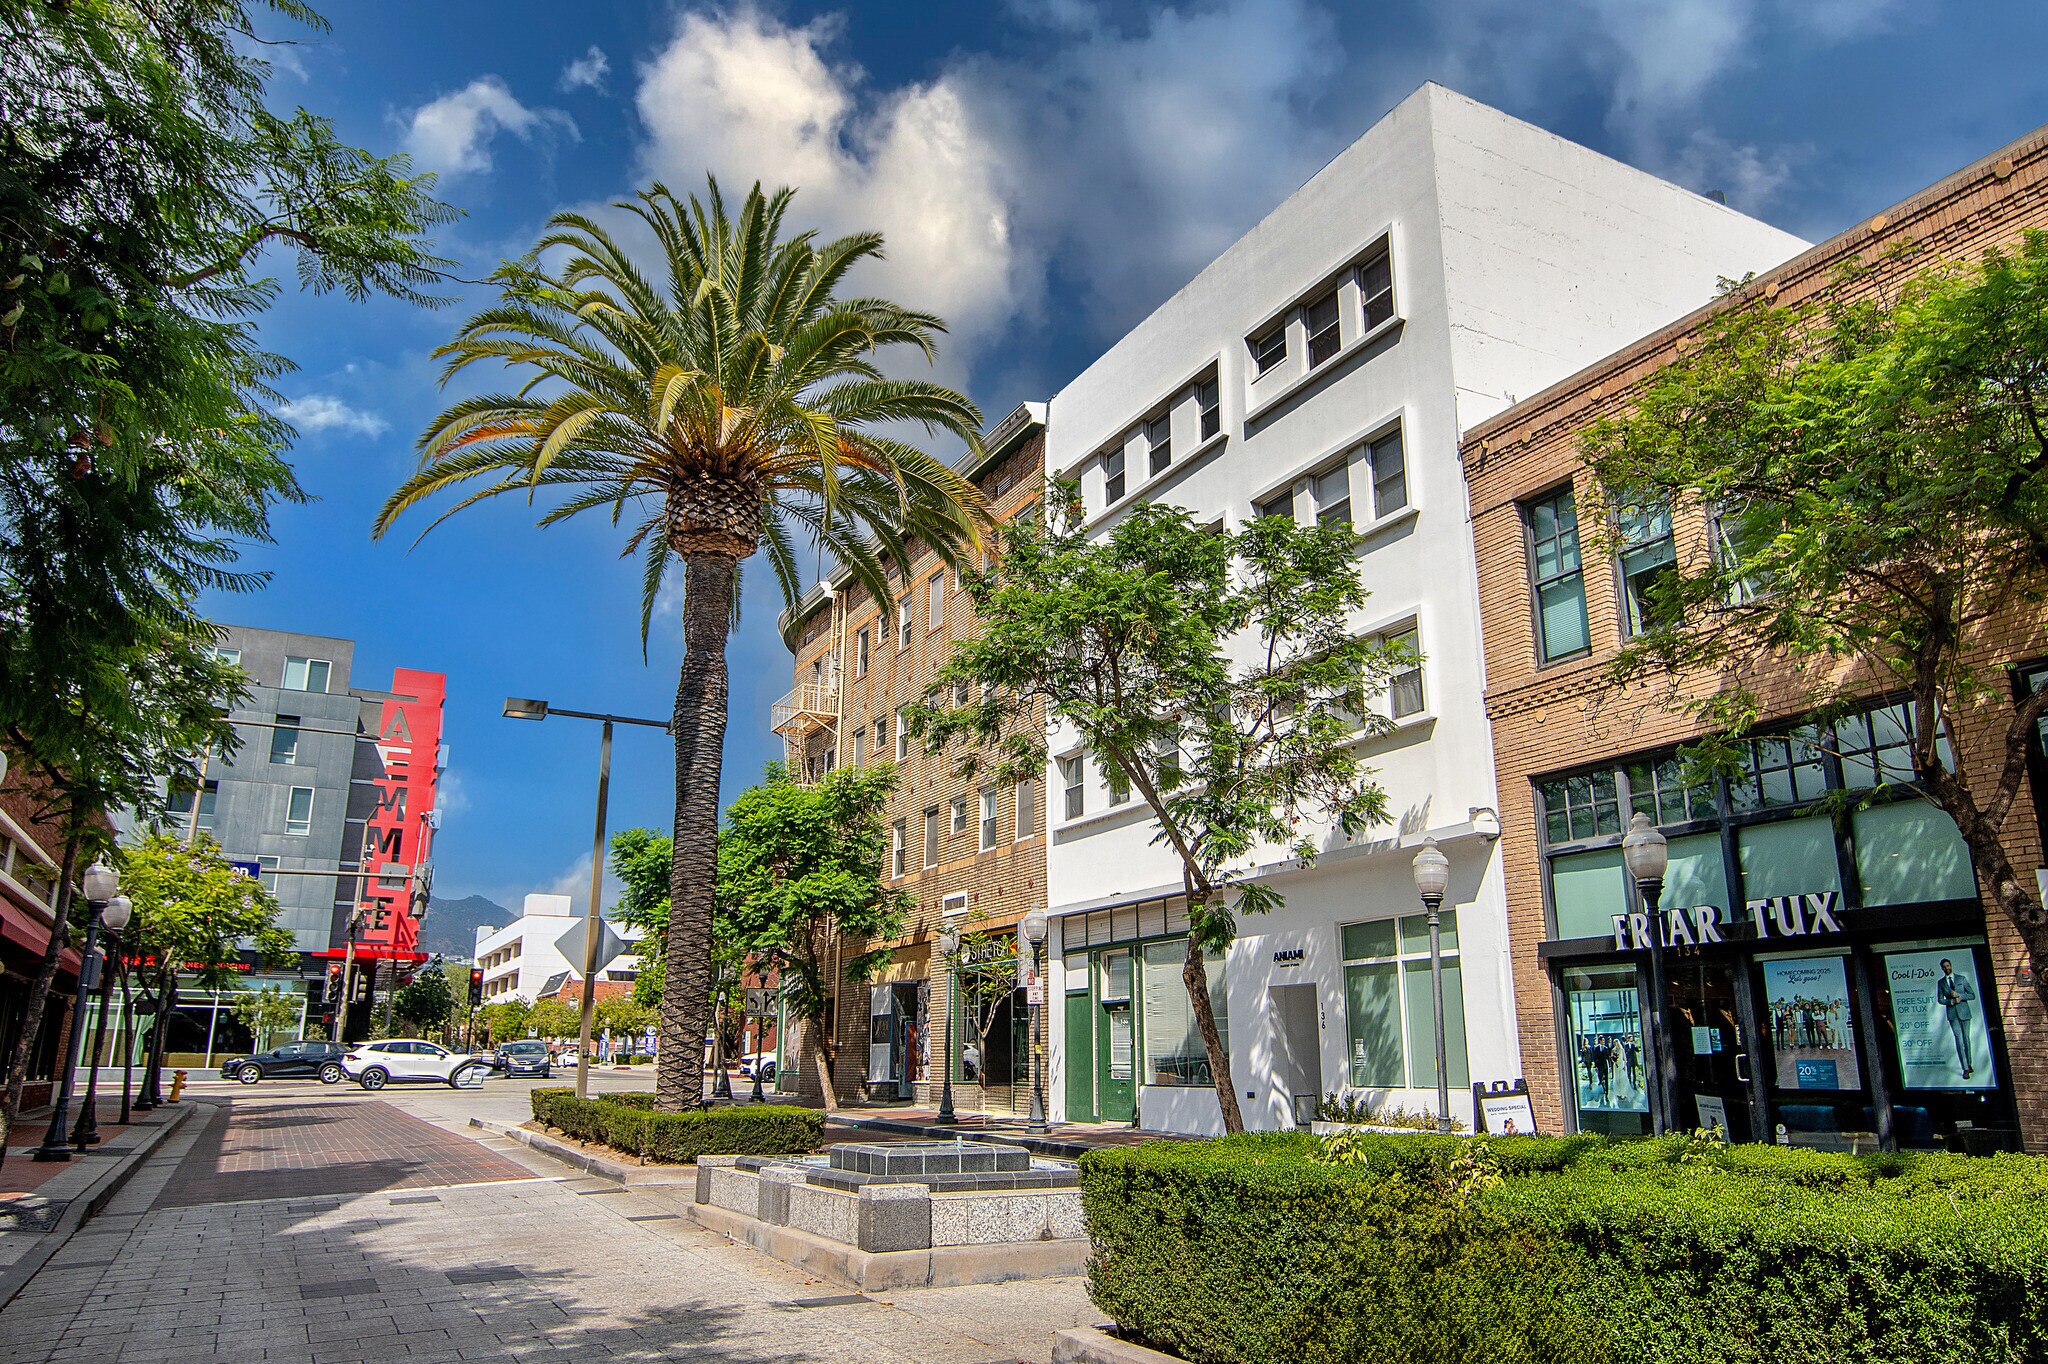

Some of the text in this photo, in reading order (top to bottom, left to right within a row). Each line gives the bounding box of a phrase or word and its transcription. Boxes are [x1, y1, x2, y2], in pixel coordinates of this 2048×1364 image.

[1611, 891, 1841, 951] FRIAR TUX
[1676, 945, 1700, 957] 134
[1776, 967, 1831, 977] HOMECOMING 2025
[1891, 969, 1910, 981] Cool
[1896, 996, 1935, 1006] FREE SUIT
[1897, 1005, 1928, 1014] OR TUX
[1914, 1021, 1930, 1029] OFF
[1916, 1039, 1933, 1047] OFF
[1798, 1066, 1817, 1076] 20%
